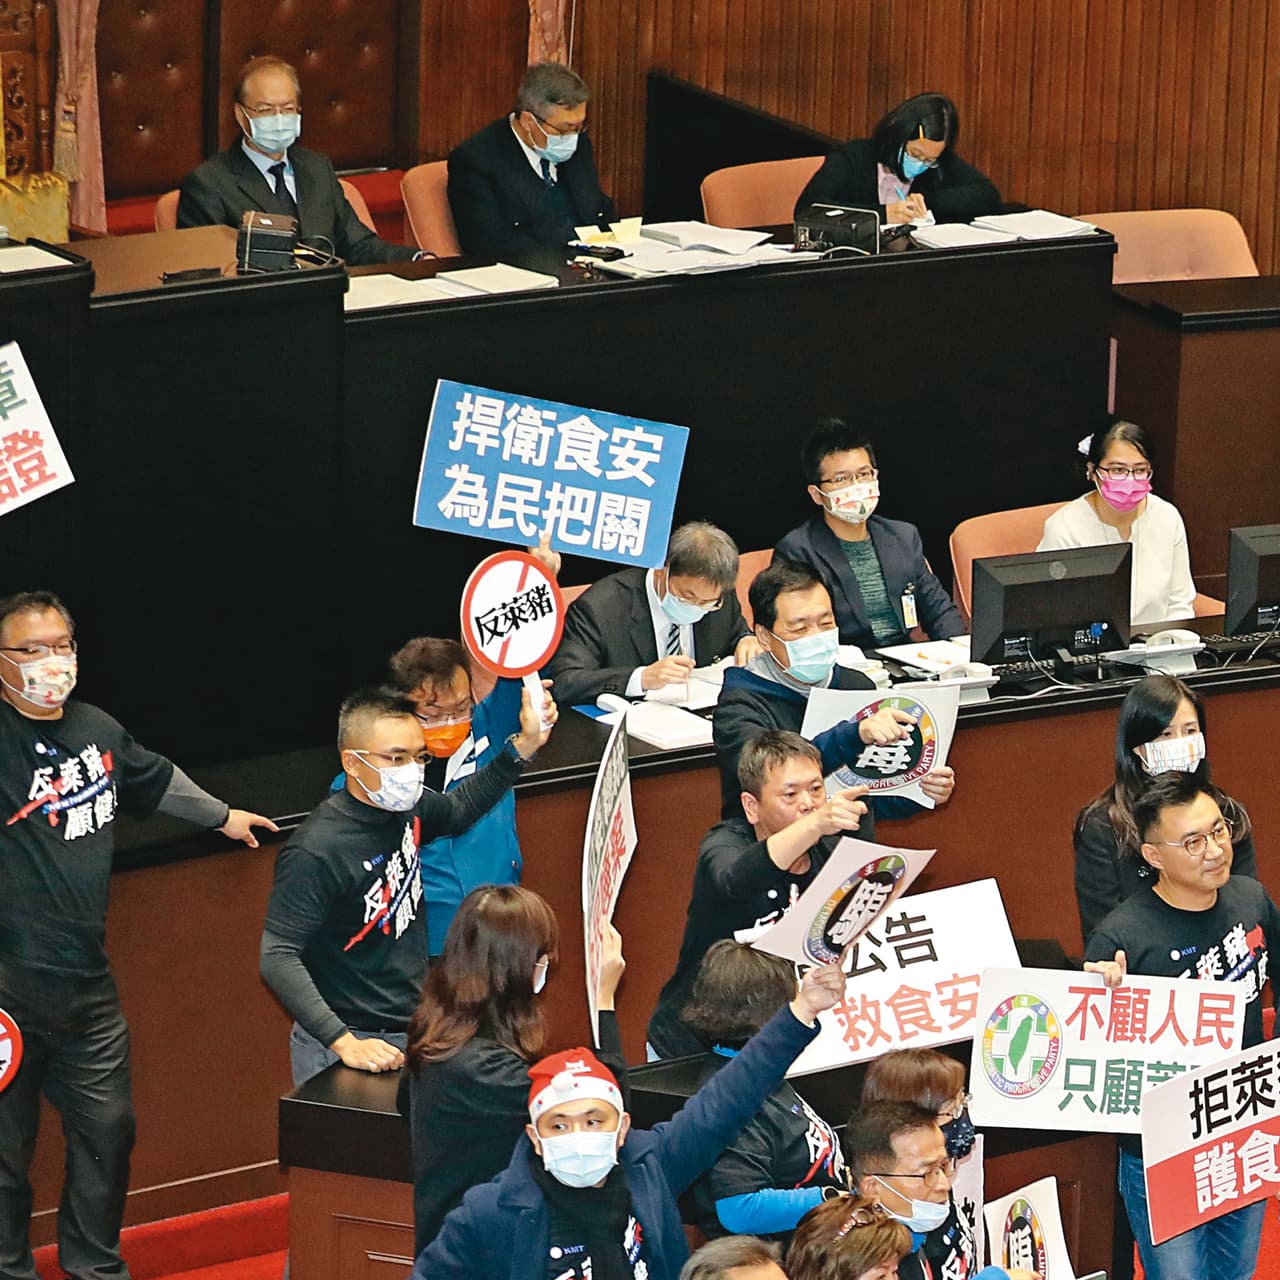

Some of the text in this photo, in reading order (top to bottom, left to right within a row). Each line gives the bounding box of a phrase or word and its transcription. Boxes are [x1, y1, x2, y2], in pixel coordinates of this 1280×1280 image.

[449, 392, 664, 487] 捍衛食安
[437, 464, 651, 556] 為民把關
[475, 584, 553, 647] 反萊豬
[918, 744, 935, 774] PARTY
[797, 911, 938, 978] 公告
[1178, 923, 1250, 981] 萊豬
[1181, 946, 1197, 956] KMT
[833, 973, 981, 1051] 救食安
[1065, 986, 1235, 1049] 不顧人民
[1047, 1041, 1058, 1071] PARTY
[563, 1245, 584, 1255] KMT
